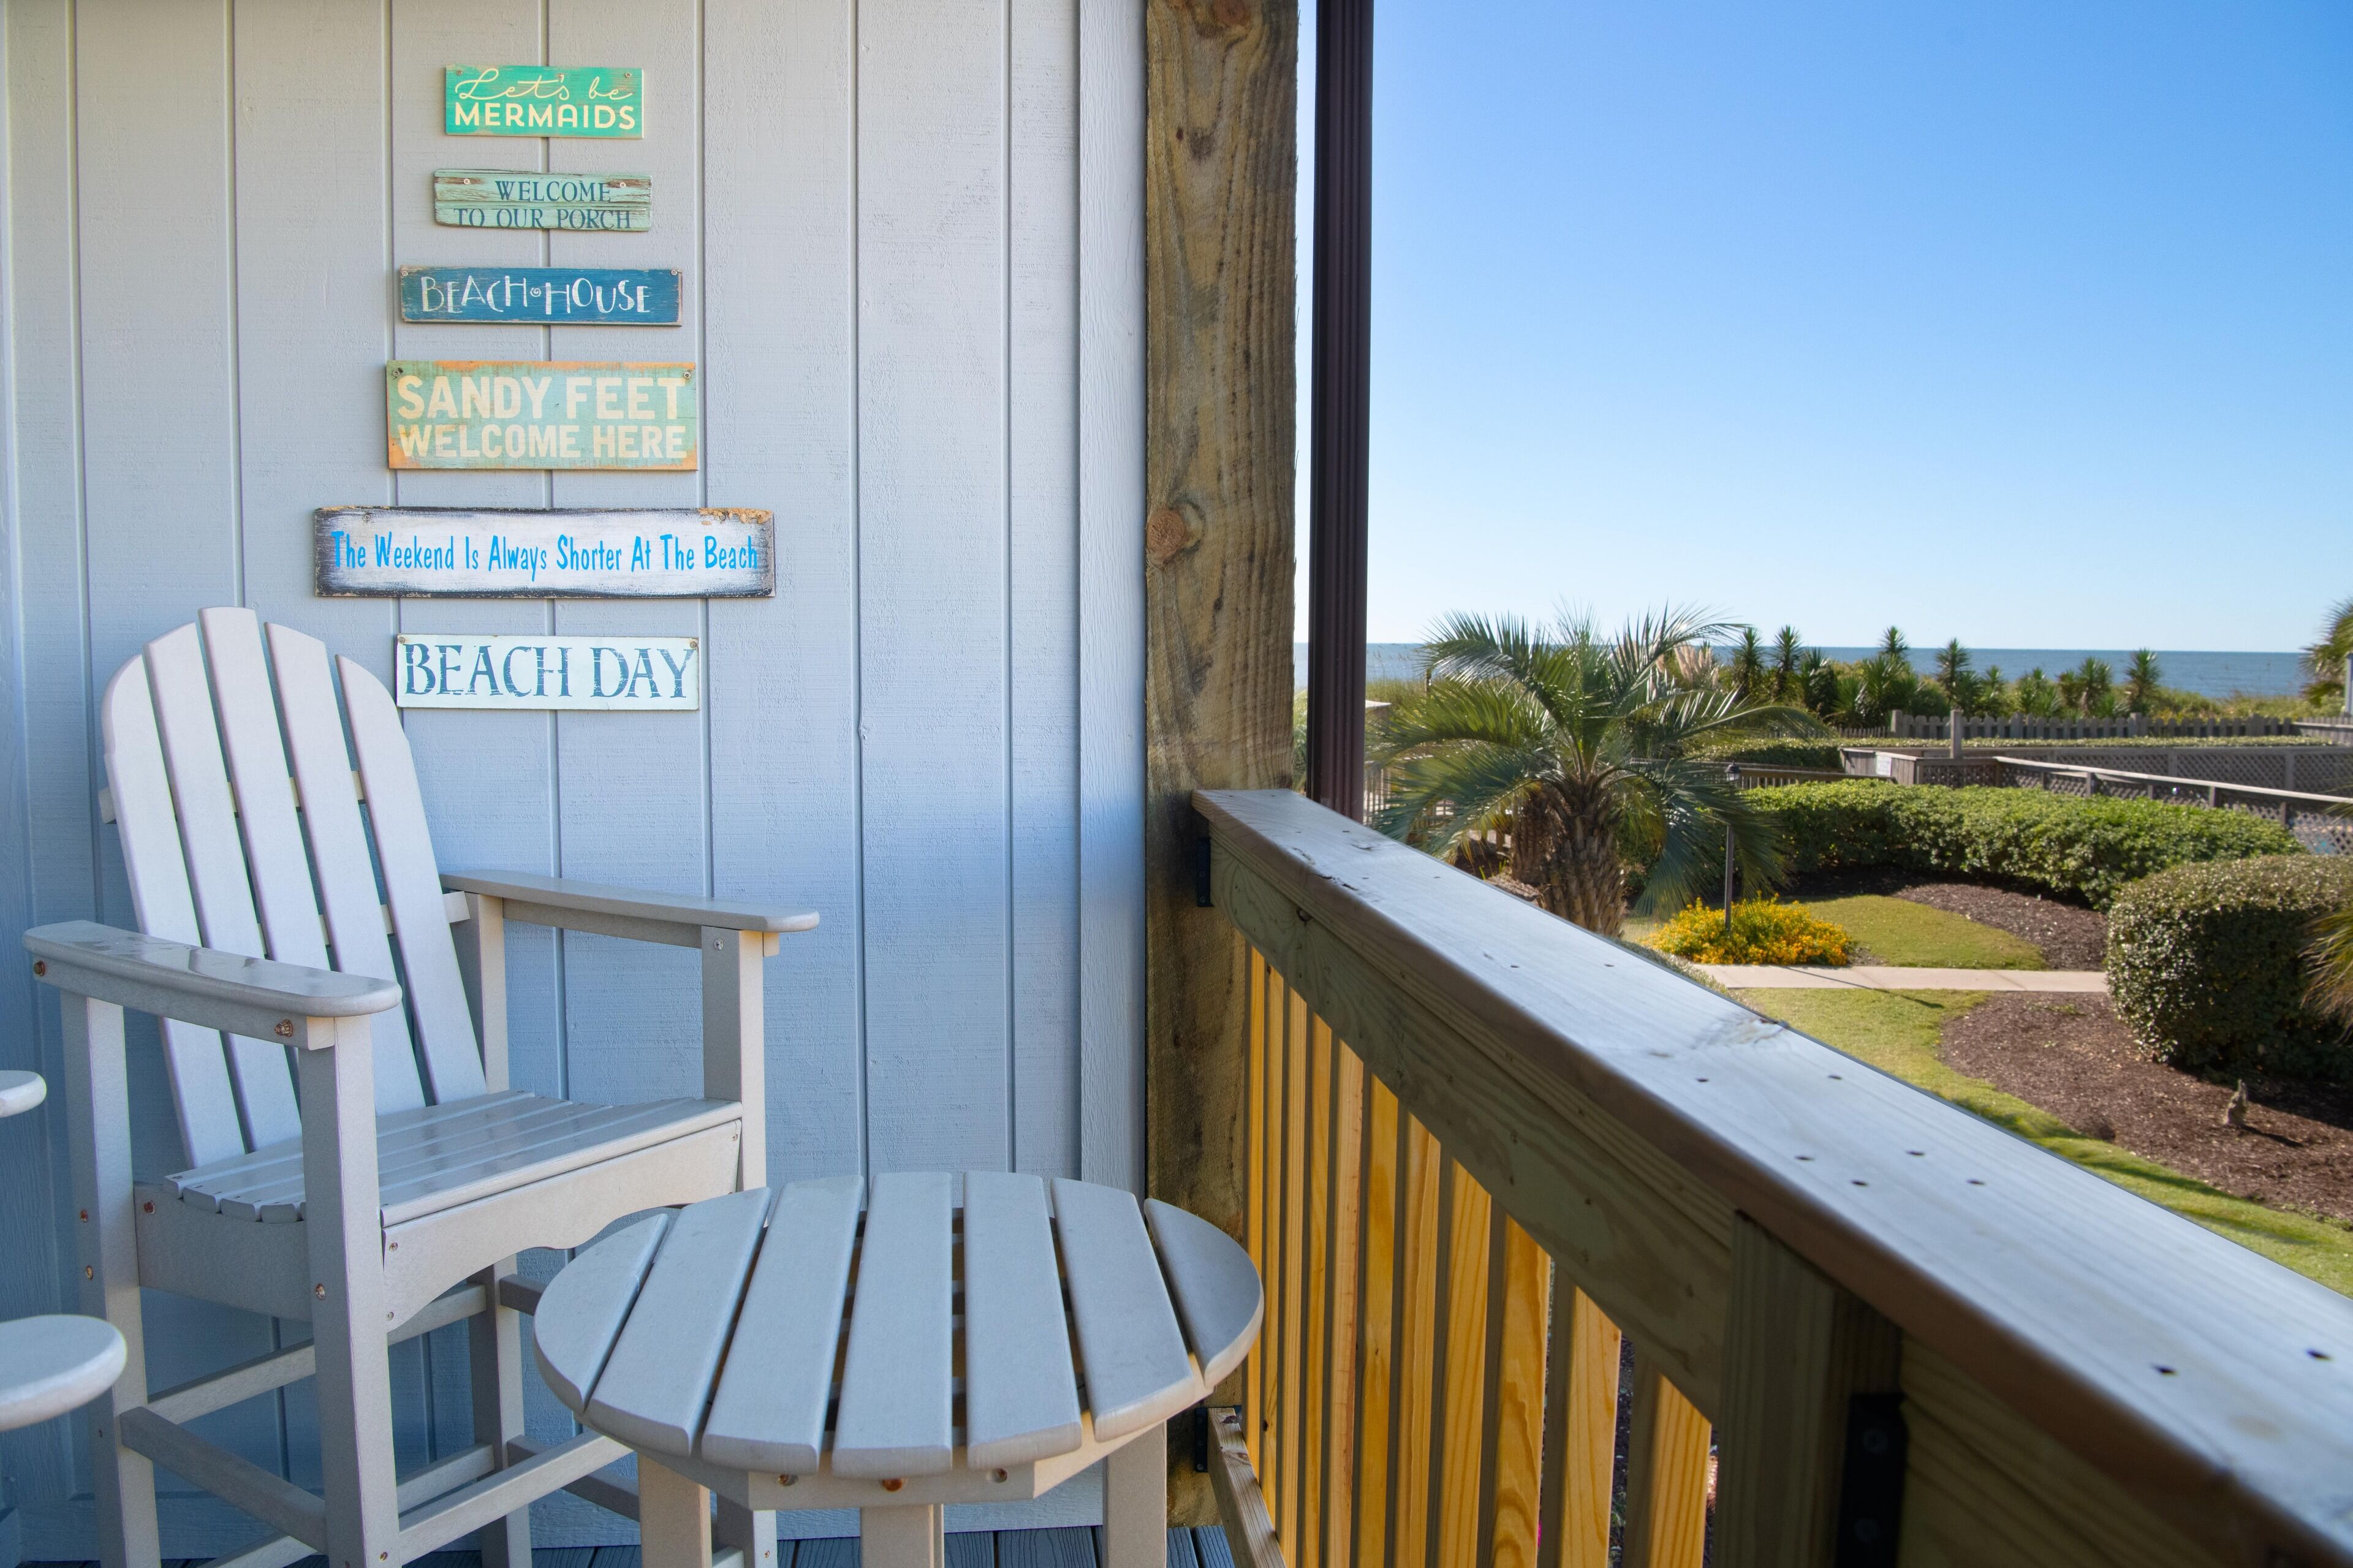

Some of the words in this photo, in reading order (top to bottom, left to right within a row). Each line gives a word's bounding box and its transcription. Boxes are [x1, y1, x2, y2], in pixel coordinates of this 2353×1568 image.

[455, 68, 570, 100] Let's
[588, 77, 633, 100] be
[455, 102, 635, 130] MERMAIDS
[495, 180, 611, 202] WELCOME
[453, 208, 485, 227] TO
[496, 208, 543, 229] OUR
[556, 208, 631, 229] PORCH
[421, 275, 528, 312] BEACH
[545, 278, 651, 315] HOUSE
[397, 375, 553, 420] SANDY
[566, 376, 684, 421] FEET
[397, 423, 580, 458] WELCOME
[594, 425, 687, 459] HERE
[331, 531, 366, 569] The
[374, 531, 454, 570] Weekend
[465, 536, 479, 570] Is
[488, 535, 547, 581] Always
[556, 534, 622, 572] Shorter
[631, 536, 651, 572] At
[659, 533, 695, 570] The
[705, 535, 758, 570] Beach
[404, 643, 574, 697] BEACH
[590, 647, 696, 699] DAY
